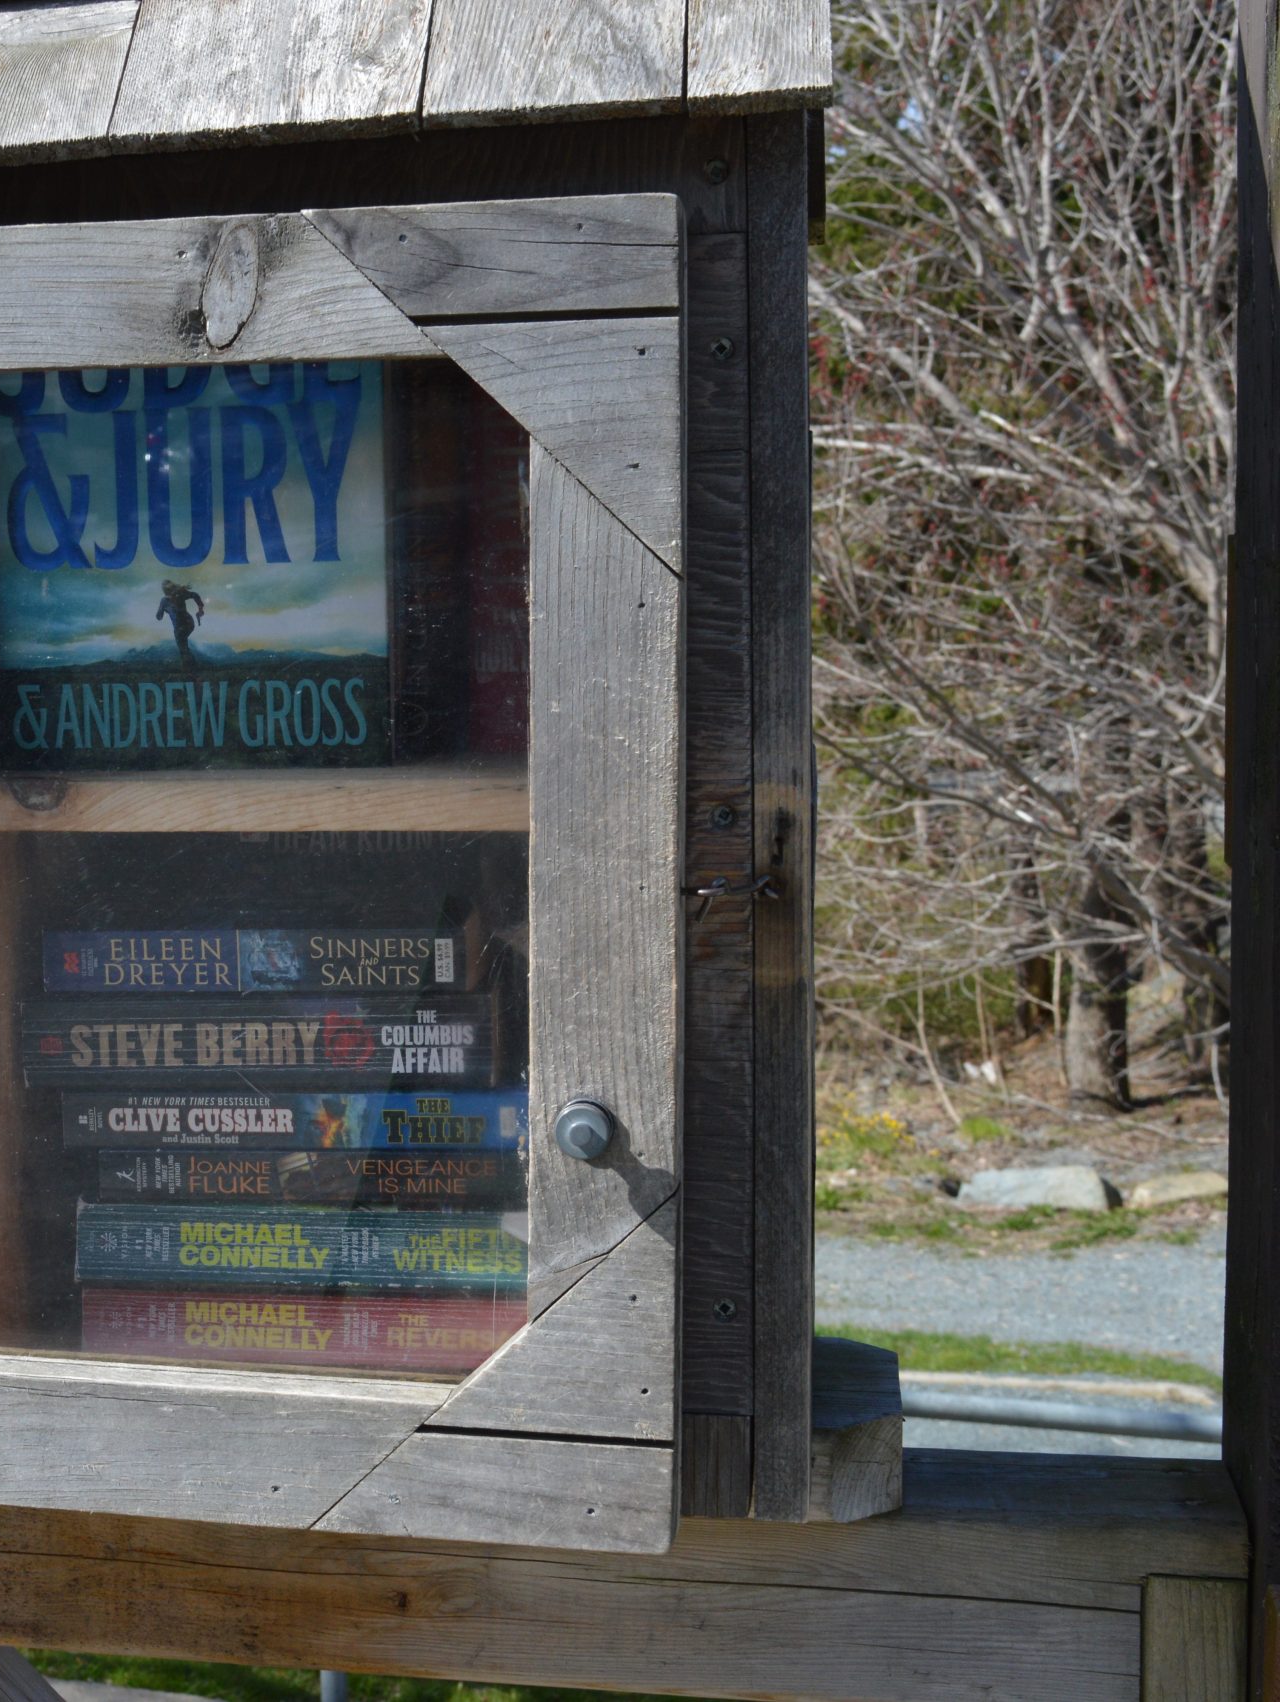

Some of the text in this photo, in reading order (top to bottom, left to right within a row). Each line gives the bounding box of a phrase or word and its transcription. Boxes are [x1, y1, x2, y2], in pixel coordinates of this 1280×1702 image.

[5, 409, 93, 571] &
[92, 398, 363, 571] JURY
[12, 677, 368, 750] & ANDREW GROSS
[109, 938, 222, 961] EILEEN
[309, 936, 431, 959] SINNERS
[359, 956, 379, 967] AND
[103, 962, 233, 986] DREYER
[321, 963, 421, 987] SAINTS
[415, 1009, 438, 1024] THE
[69, 1022, 184, 1067] STEVE
[195, 1021, 321, 1066] BERRY
[380, 1024, 475, 1047] COLUMBUS
[391, 1047, 465, 1074] AFFAIR
[141, 1097, 162, 1106] NEW
[164, 1097, 187, 1106] YORK
[188, 1097, 216, 1107] TIMES
[217, 1097, 271, 1107] BESTSELLER
[415, 1097, 451, 1114] THE
[107, 1107, 295, 1134] CLIVE CUSSLER
[380, 1109, 488, 1146] THIEF
[161, 1132, 240, 1145] and Justin Scott
[186, 1154, 273, 1175] JOANNE
[345, 1158, 498, 1176] VENGEANCE
[188, 1175, 272, 1195] FLUKE
[378, 1177, 468, 1196] IS MINE
[178, 1221, 311, 1245] MICHAEL
[408, 1234, 441, 1249] THE
[178, 1245, 331, 1270] CONNELLY
[392, 1248, 523, 1274] WITNESS
[183, 1301, 314, 1327] MICHAEL
[397, 1312, 430, 1327] THE
[183, 1326, 335, 1351] CONNELLY
